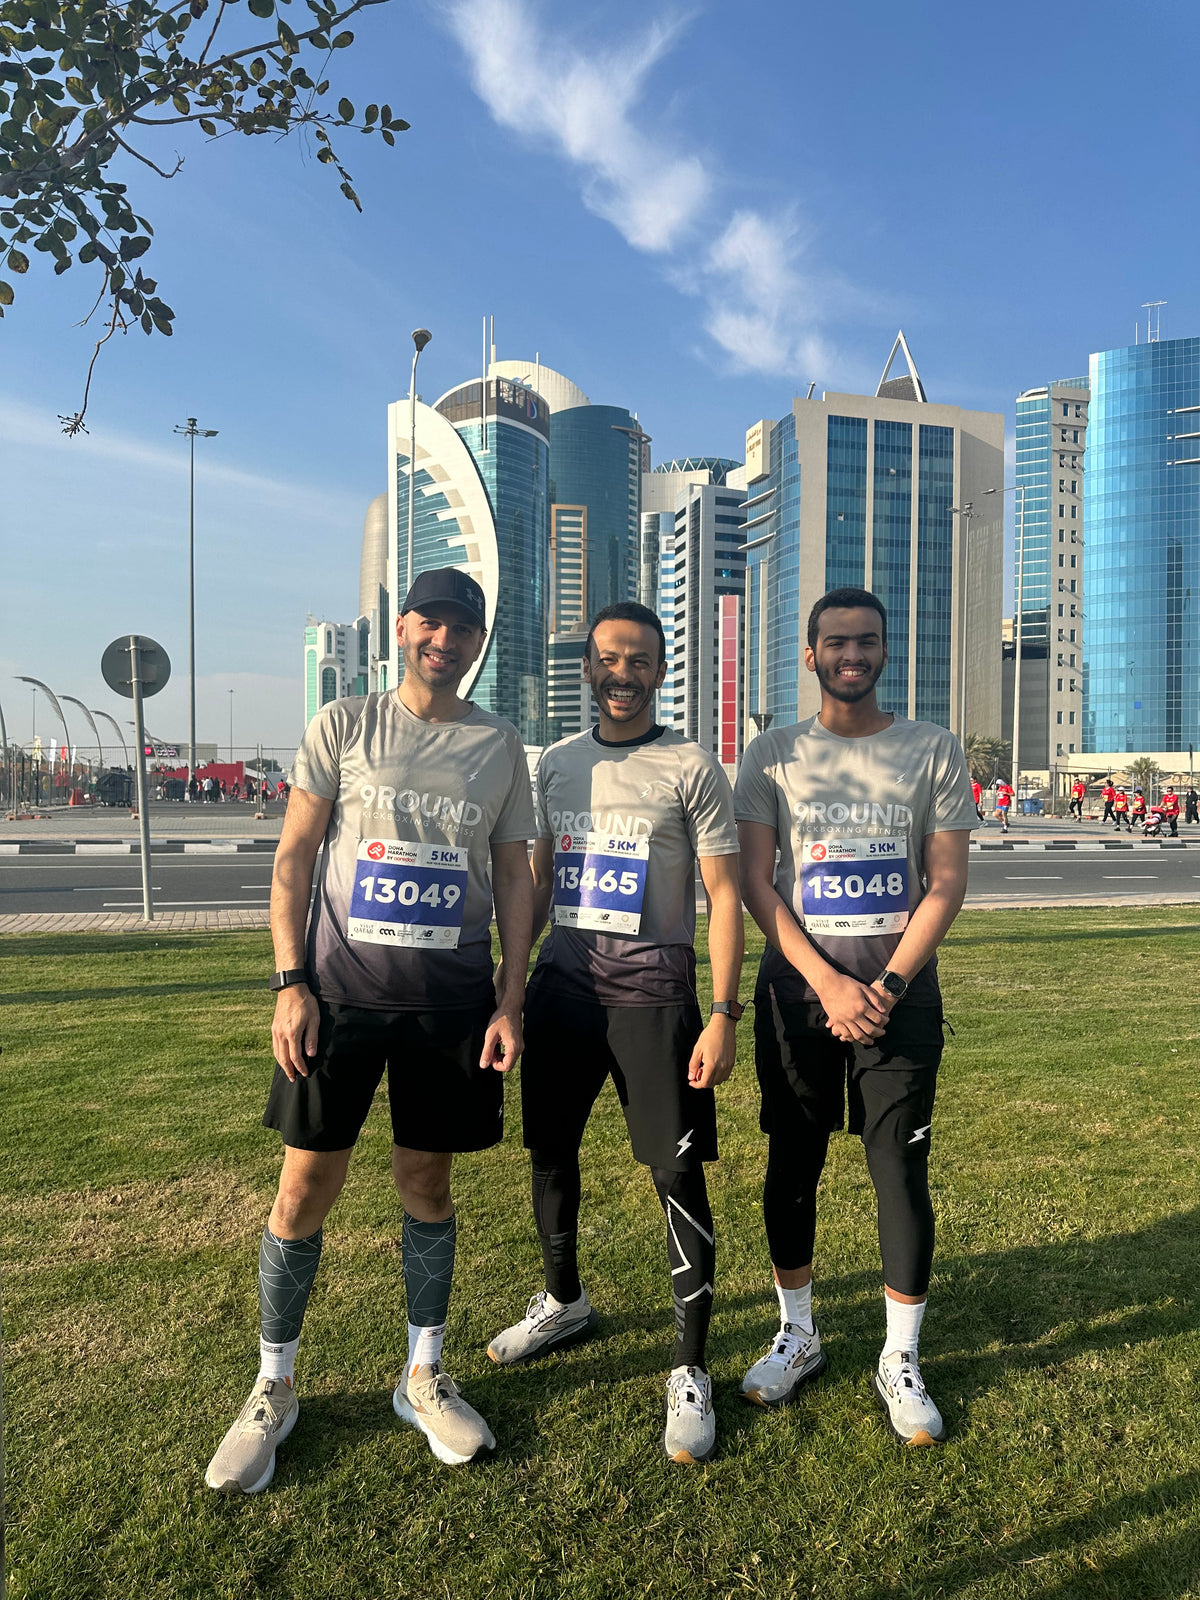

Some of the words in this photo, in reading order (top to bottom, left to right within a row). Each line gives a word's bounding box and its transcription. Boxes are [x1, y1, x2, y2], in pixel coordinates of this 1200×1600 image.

[360, 784, 482, 826] 9ROUND
[793, 801, 913, 828] 9ROUND
[362, 811, 430, 827] KICKBOXING
[551, 810, 653, 838] 9ROUND
[388, 850, 417, 858] MARATHON
[431, 850, 438, 860] 5
[440, 851, 459, 863] KM
[608, 840, 615, 849] 5
[617, 840, 637, 852] KM
[869, 843, 876, 853] 5
[879, 842, 896, 853] KM
[359, 876, 461, 909] 13049
[557, 866, 638, 895] 13465
[807, 872, 904, 899] 13048
